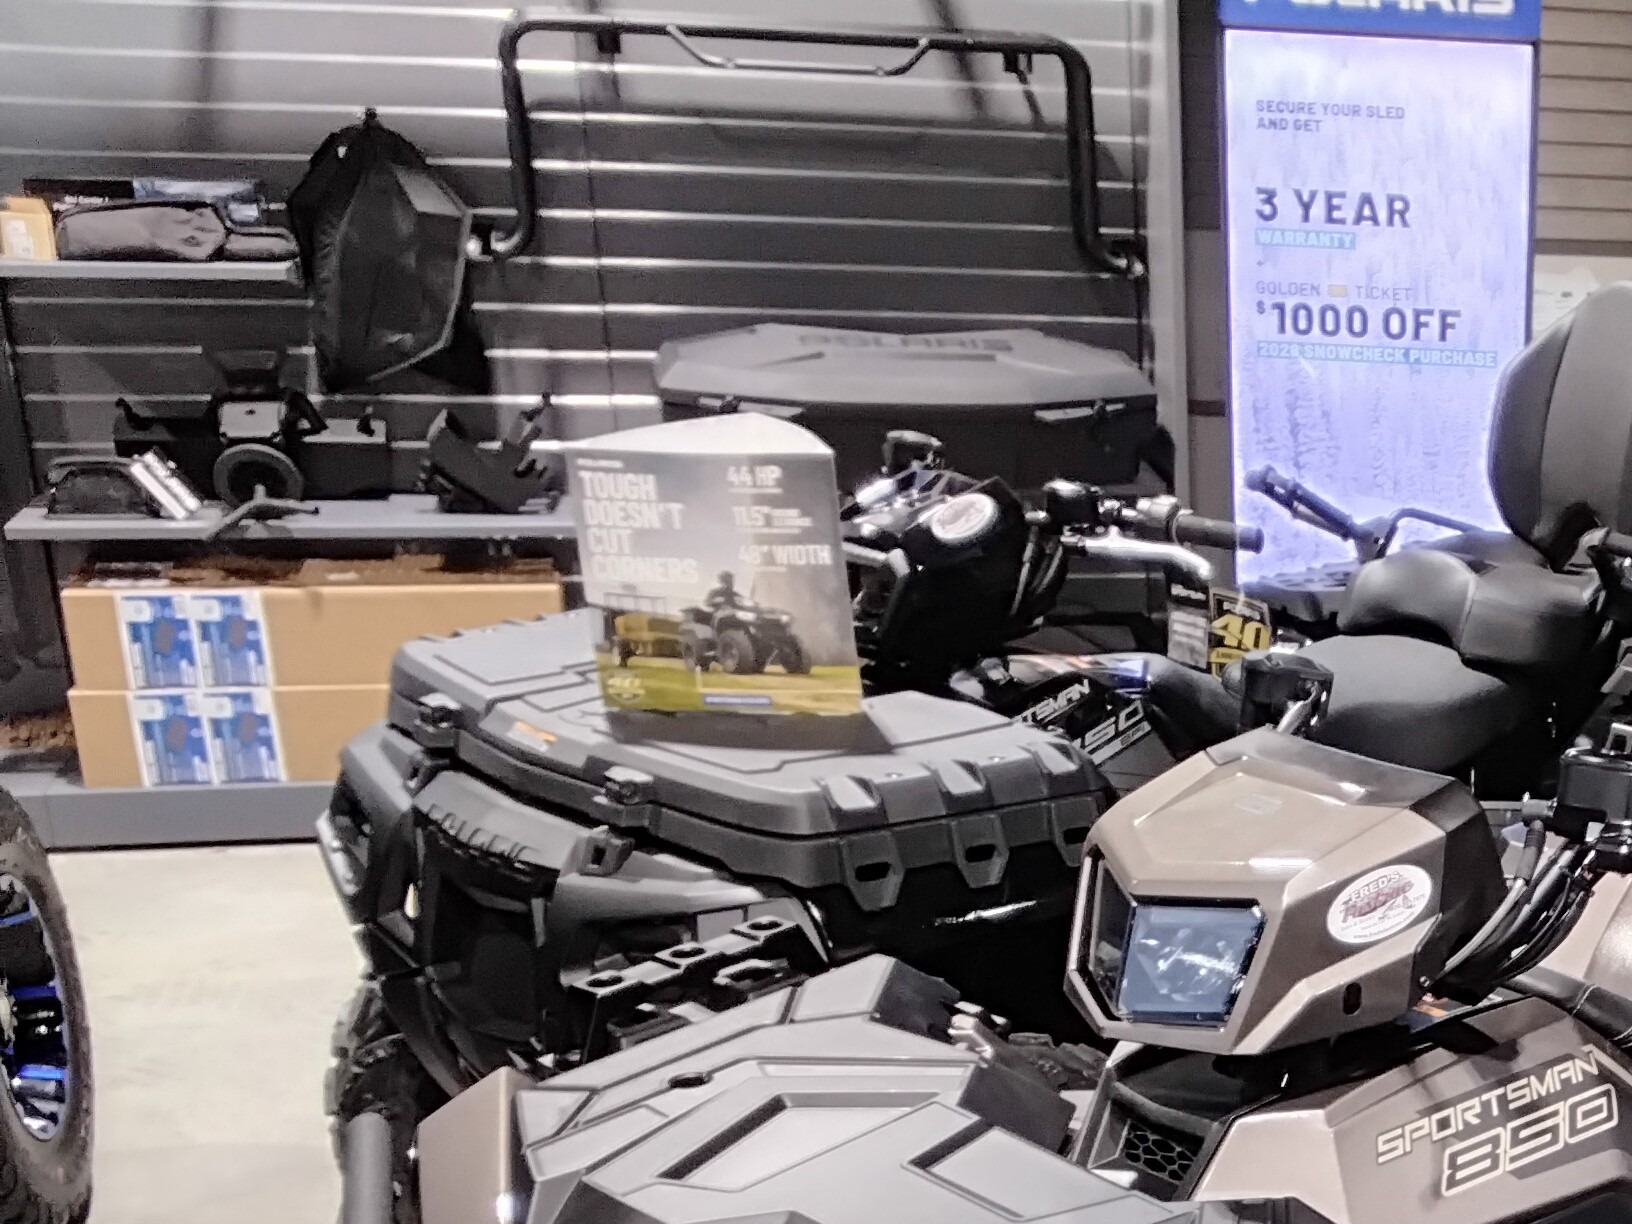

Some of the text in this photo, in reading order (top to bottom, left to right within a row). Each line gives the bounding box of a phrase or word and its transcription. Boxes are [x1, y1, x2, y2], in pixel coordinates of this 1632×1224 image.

[1256, 100, 1405, 120] SECURE YOUR SLED
[1256, 118, 1323, 133] AND GET
[1255, 186, 1412, 229] 3 YEAR
[1257, 230, 1354, 249] WARRANTY
[1256, 280, 1413, 302] GOLDEN TICKET
[1382, 307, 1461, 343] OFF
[1303, 344, 1405, 364] SNOWCHECK
[1410, 349, 1496, 368] PURCHASE
[578, 465, 783, 500] TOUGH 44 HP
[583, 500, 687, 530] DOESN'T
[587, 528, 633, 554] CUT
[771, 544, 831, 566] WIDTH
[591, 556, 700, 583] CORNERS
[1018, 678, 1092, 724] TSMAN
[1377, 1050, 1599, 1165] SPORTSMAN
[1441, 1083, 1619, 1198] 850
